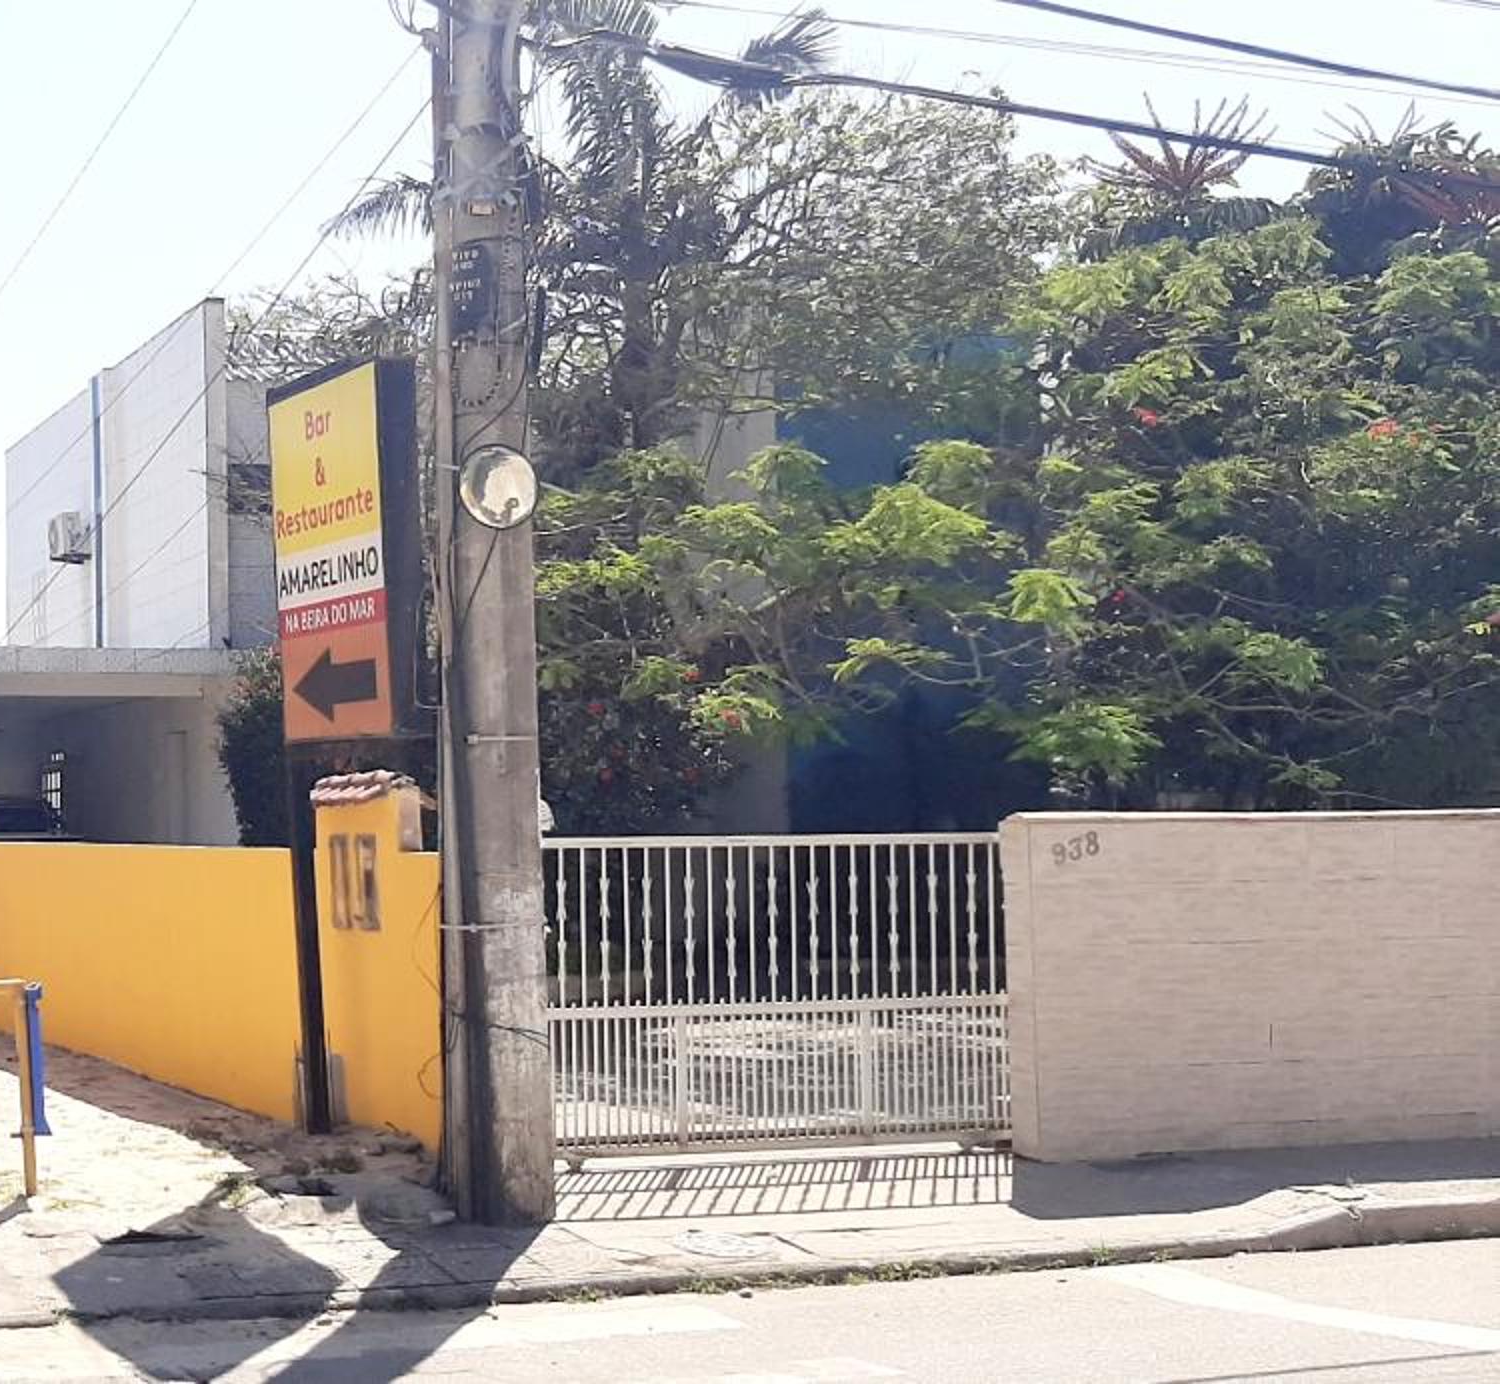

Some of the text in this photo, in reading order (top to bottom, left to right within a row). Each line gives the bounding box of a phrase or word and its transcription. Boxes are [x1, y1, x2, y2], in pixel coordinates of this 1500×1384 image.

[304, 410, 331, 440] Bar
[314, 457, 326, 487] &
[277, 487, 374, 539] Restaurante
[279, 546, 379, 599] AMARELINHO
[285, 597, 376, 633] NA BEIRA DO MAR
[1051, 830, 1099, 866] 938
